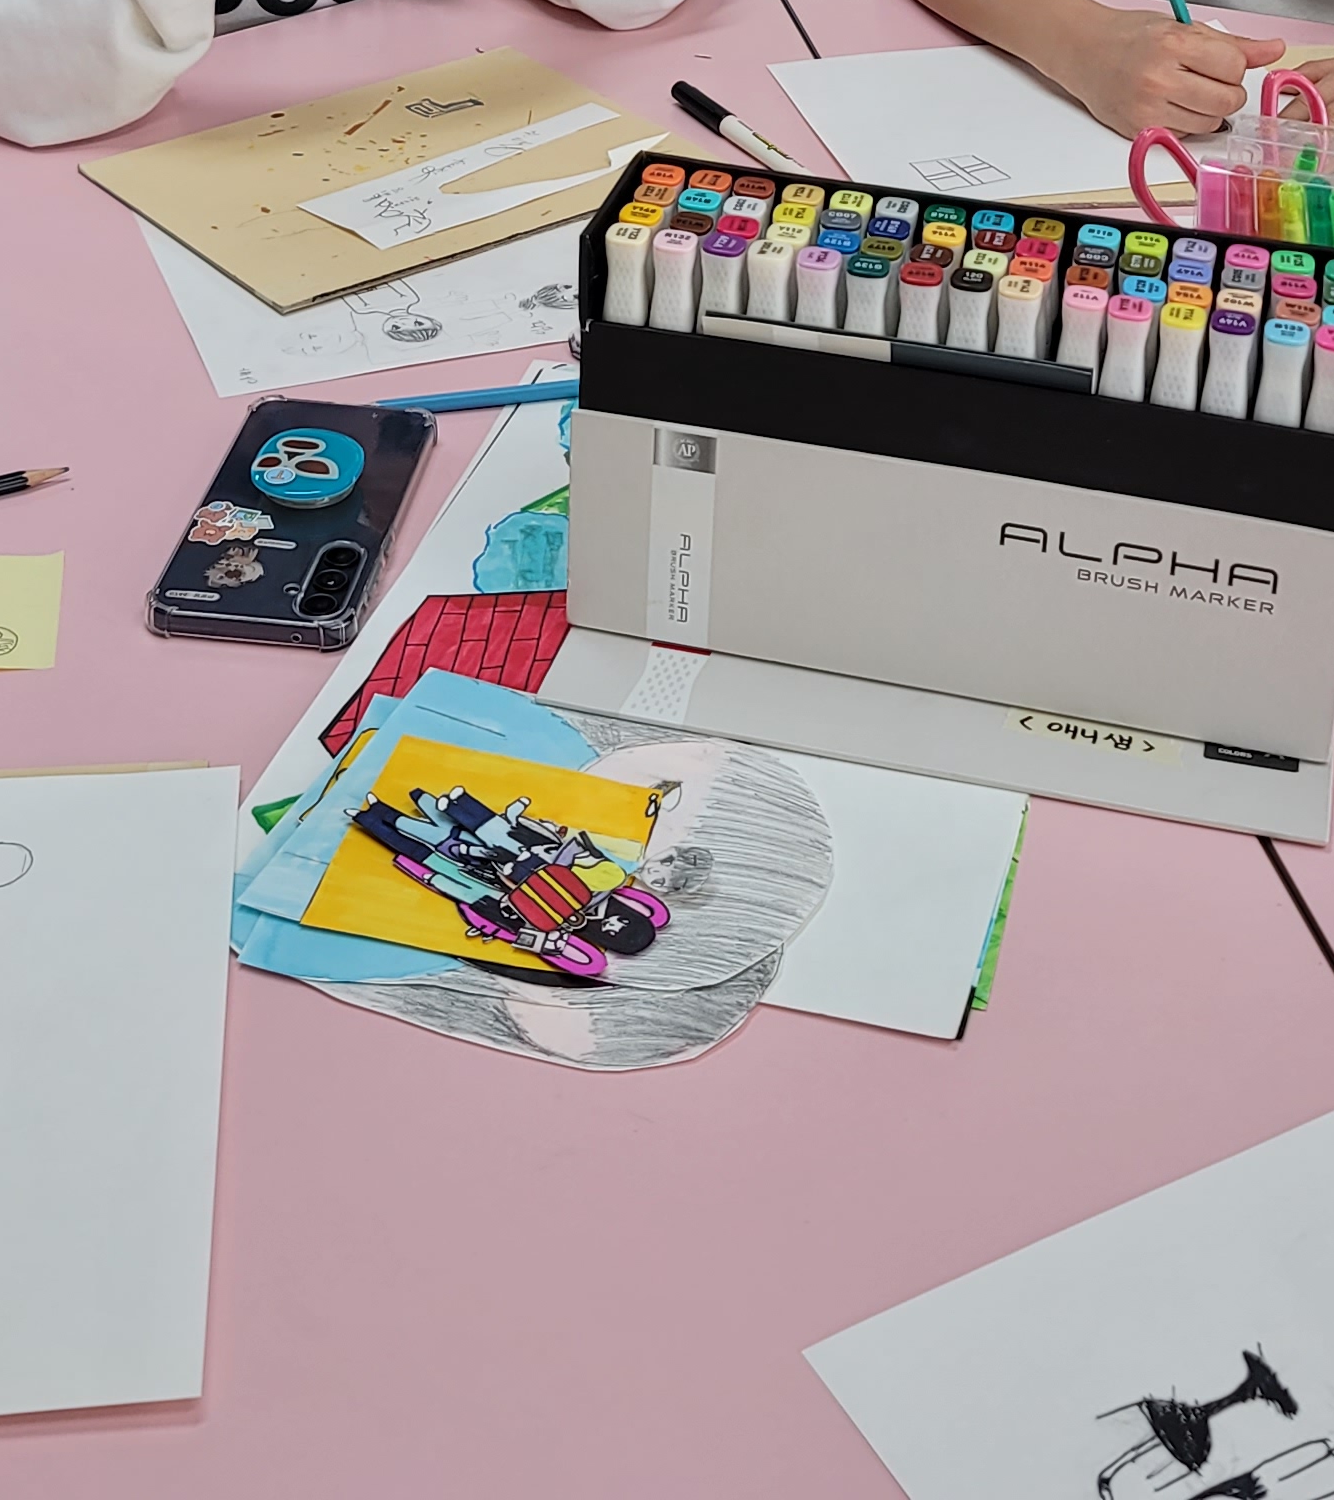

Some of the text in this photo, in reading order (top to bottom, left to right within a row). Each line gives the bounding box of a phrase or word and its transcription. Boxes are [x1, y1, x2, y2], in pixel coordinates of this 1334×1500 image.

[828, 210, 857, 219] CG07
[1079, 252, 1109, 262] CG09
[676, 441, 698, 459] AP
[999, 522, 1279, 595] ALPHA
[668, 550, 678, 621] BRUSH MARKER
[676, 533, 692, 624] ALPHA
[1076, 568, 1275, 616] BRUSH MARKER
[1047, 720, 1134, 751] 애니샘
[1217, 746, 1253, 759] COLORS
